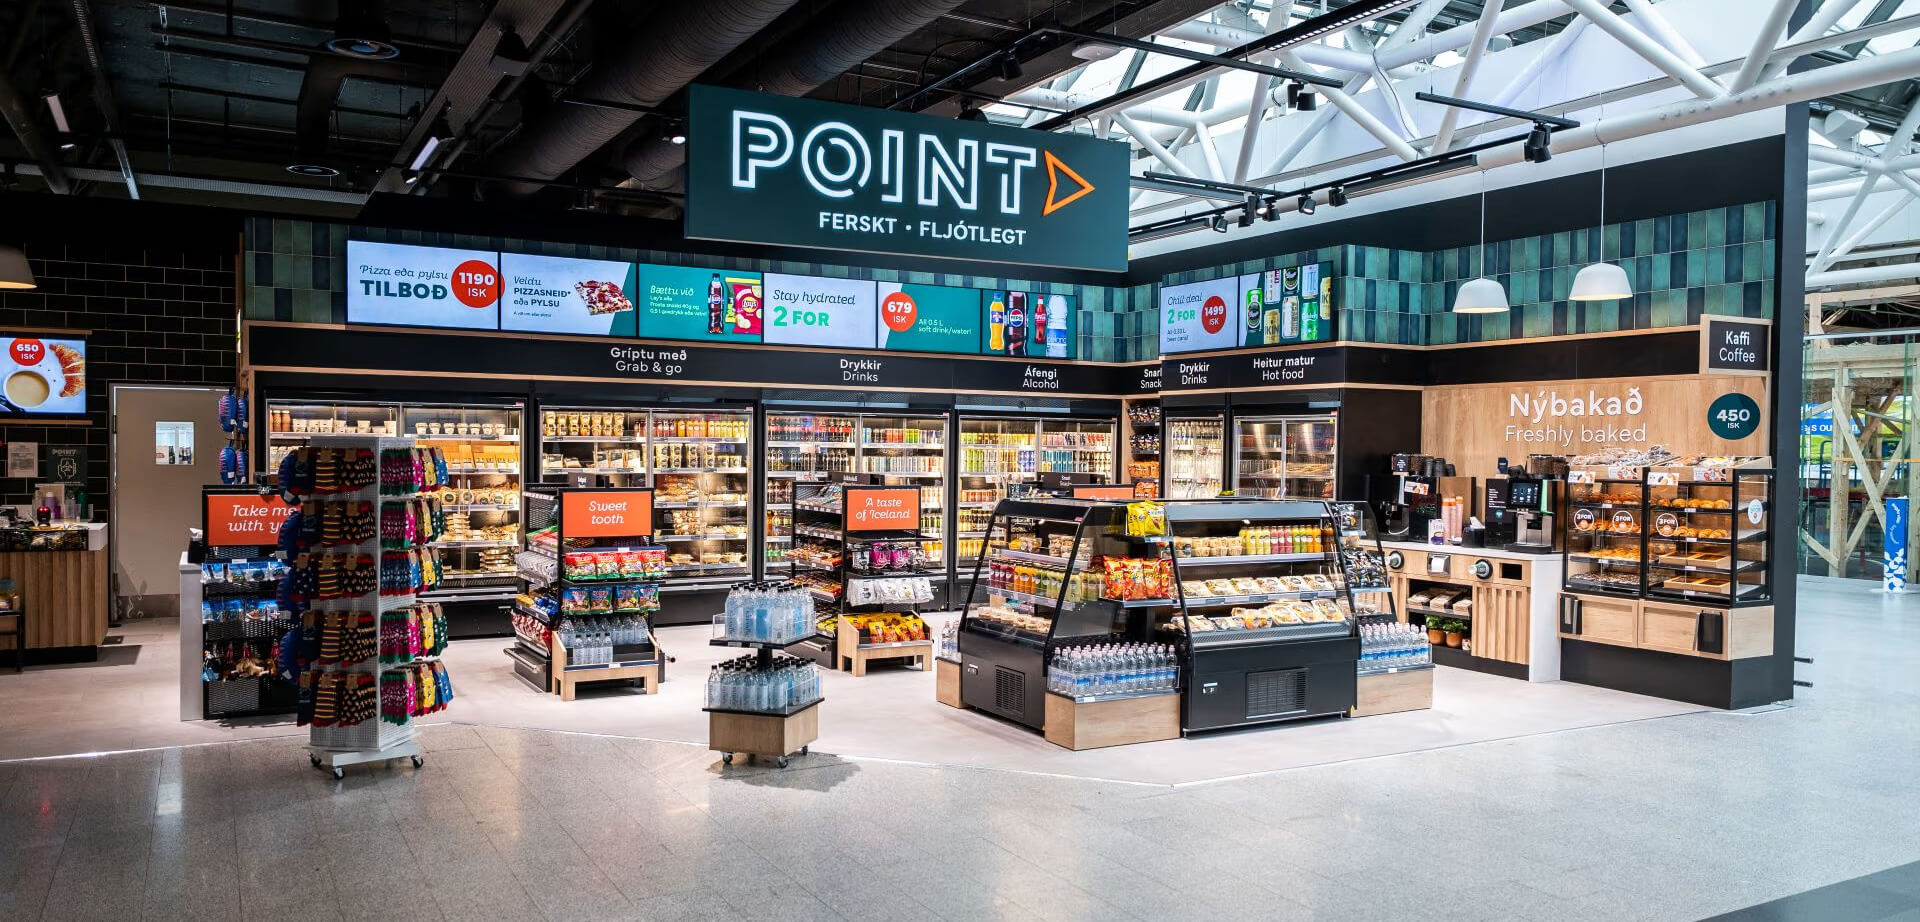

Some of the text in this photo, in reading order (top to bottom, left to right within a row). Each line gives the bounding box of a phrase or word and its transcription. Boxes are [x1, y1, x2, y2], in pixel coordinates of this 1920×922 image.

[732, 109, 1037, 215] POINT
[819, 210, 1026, 245] FERSKT FLJÓTLEGT
[359, 264, 449, 281] Pizza eða pylsu
[458, 272, 495, 286] 1190
[360, 279, 449, 300] TILBOÐ
[468, 288, 487, 298] ISK
[680, 287, 694, 297] við
[531, 299, 560, 308] PYLSU
[773, 289, 856, 306] Stay hydrated
[887, 301, 913, 314] 679
[1204, 305, 1224, 317] 1499
[773, 305, 830, 327] 2 FOR
[893, 315, 907, 323] ISK
[1167, 308, 1196, 325] 2 FOR
[1209, 318, 1219, 326] ISK
[1725, 330, 1750, 346] Kaffi
[16, 344, 39, 353] 650
[610, 347, 687, 361] Gríptu með
[1719, 347, 1756, 363] Coffee
[615, 361, 682, 376] Grab & go
[840, 359, 882, 372] Drykkir
[1180, 361, 1210, 375] Drykkir
[1253, 355, 1315, 369] Heitur matur
[843, 370, 878, 382] Drinks
[1024, 365, 1057, 380] Áfengi
[1181, 374, 1208, 385] Drinks
[1262, 367, 1304, 381] Hot food
[1022, 378, 1059, 389] Alcohol
[1510, 387, 1644, 424] Nýbakað
[1716, 408, 1751, 422] 450
[1504, 422, 1647, 447] Freshly baked
[588, 500, 628, 512] Sweet
[865, 497, 902, 508] A taste
[232, 504, 298, 517] Take me
[856, 509, 910, 522] of Iceland
[228, 520, 264, 532] with
[591, 513, 624, 525] tooth
